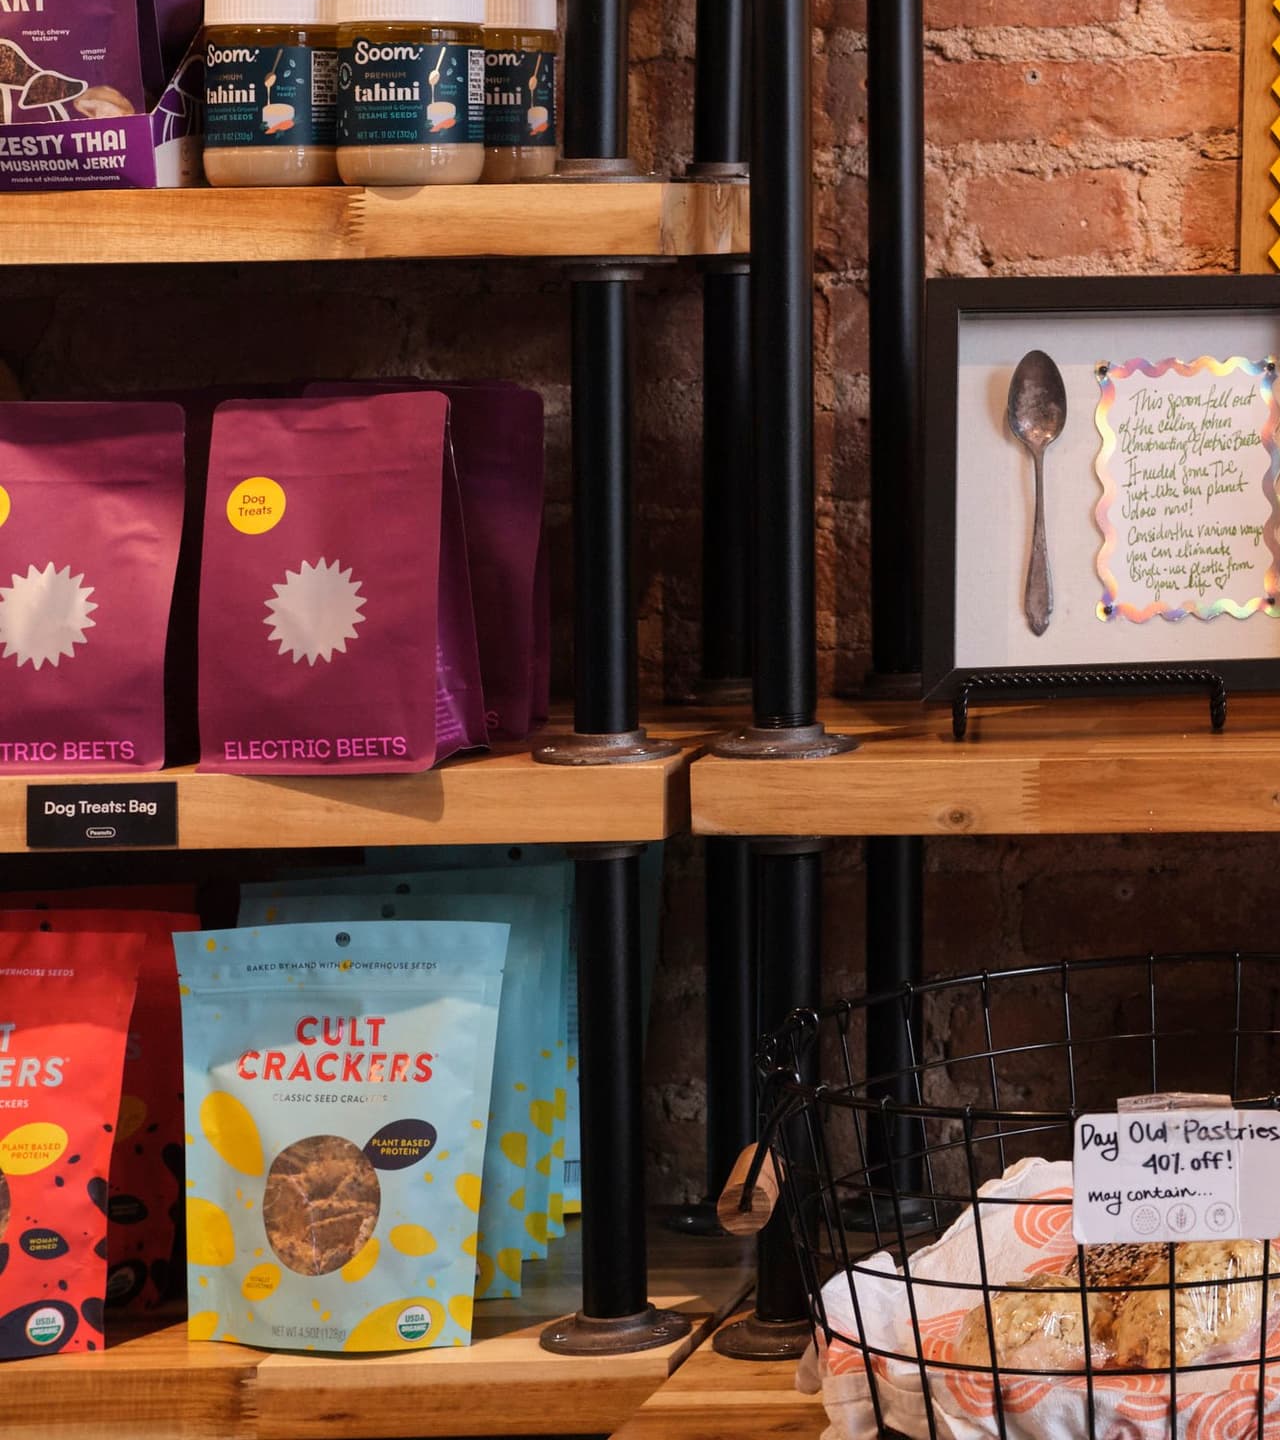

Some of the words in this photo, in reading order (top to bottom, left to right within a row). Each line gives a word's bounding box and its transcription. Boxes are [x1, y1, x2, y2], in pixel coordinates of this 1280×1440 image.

[354, 81, 421, 103] tahini
[71, 128, 127, 154] THAI
[1, 158, 79, 174] MUSHROOM
[82, 155, 127, 171] JERKY
[242, 494, 266, 506] Dog
[238, 505, 273, 518] Treats
[223, 738, 331, 761] ELECTRIC
[336, 736, 408, 759] BEETS
[44, 801, 75, 818] Dog
[78, 800, 126, 815] Treats:
[129, 799, 157, 816] Bag
[294, 1015, 386, 1048] CULT
[236, 1049, 435, 1084] CRACKERS
[371, 1138, 399, 1148] PLANT
[400, 1138, 431, 1148] BASED
[1080, 1123, 1120, 1162] Day
[1129, 1120, 1168, 1144] Old
[1183, 1118, 1280, 1145] Pastries
[380, 1147, 420, 1156] PROTEIN
[1190, 1149, 1234, 1172] off!
[1088, 1188, 1122, 1216] may
